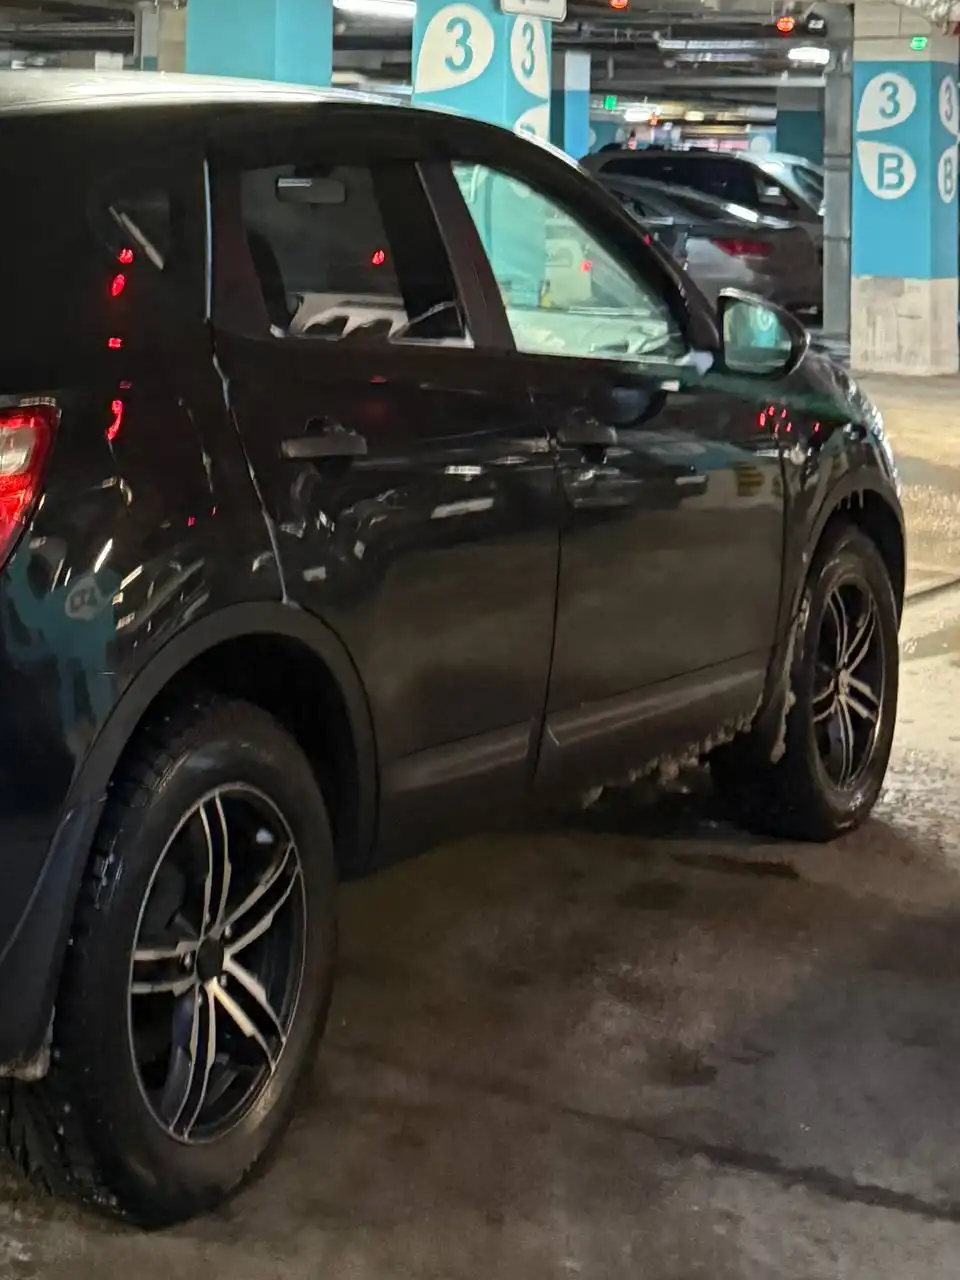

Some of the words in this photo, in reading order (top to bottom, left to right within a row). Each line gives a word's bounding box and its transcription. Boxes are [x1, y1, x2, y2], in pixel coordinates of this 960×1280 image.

[444, 16, 473, 72] 3
[521, 22, 535, 78] 3
[879, 81, 901, 119] 3
[944, 82, 953, 122] 3
